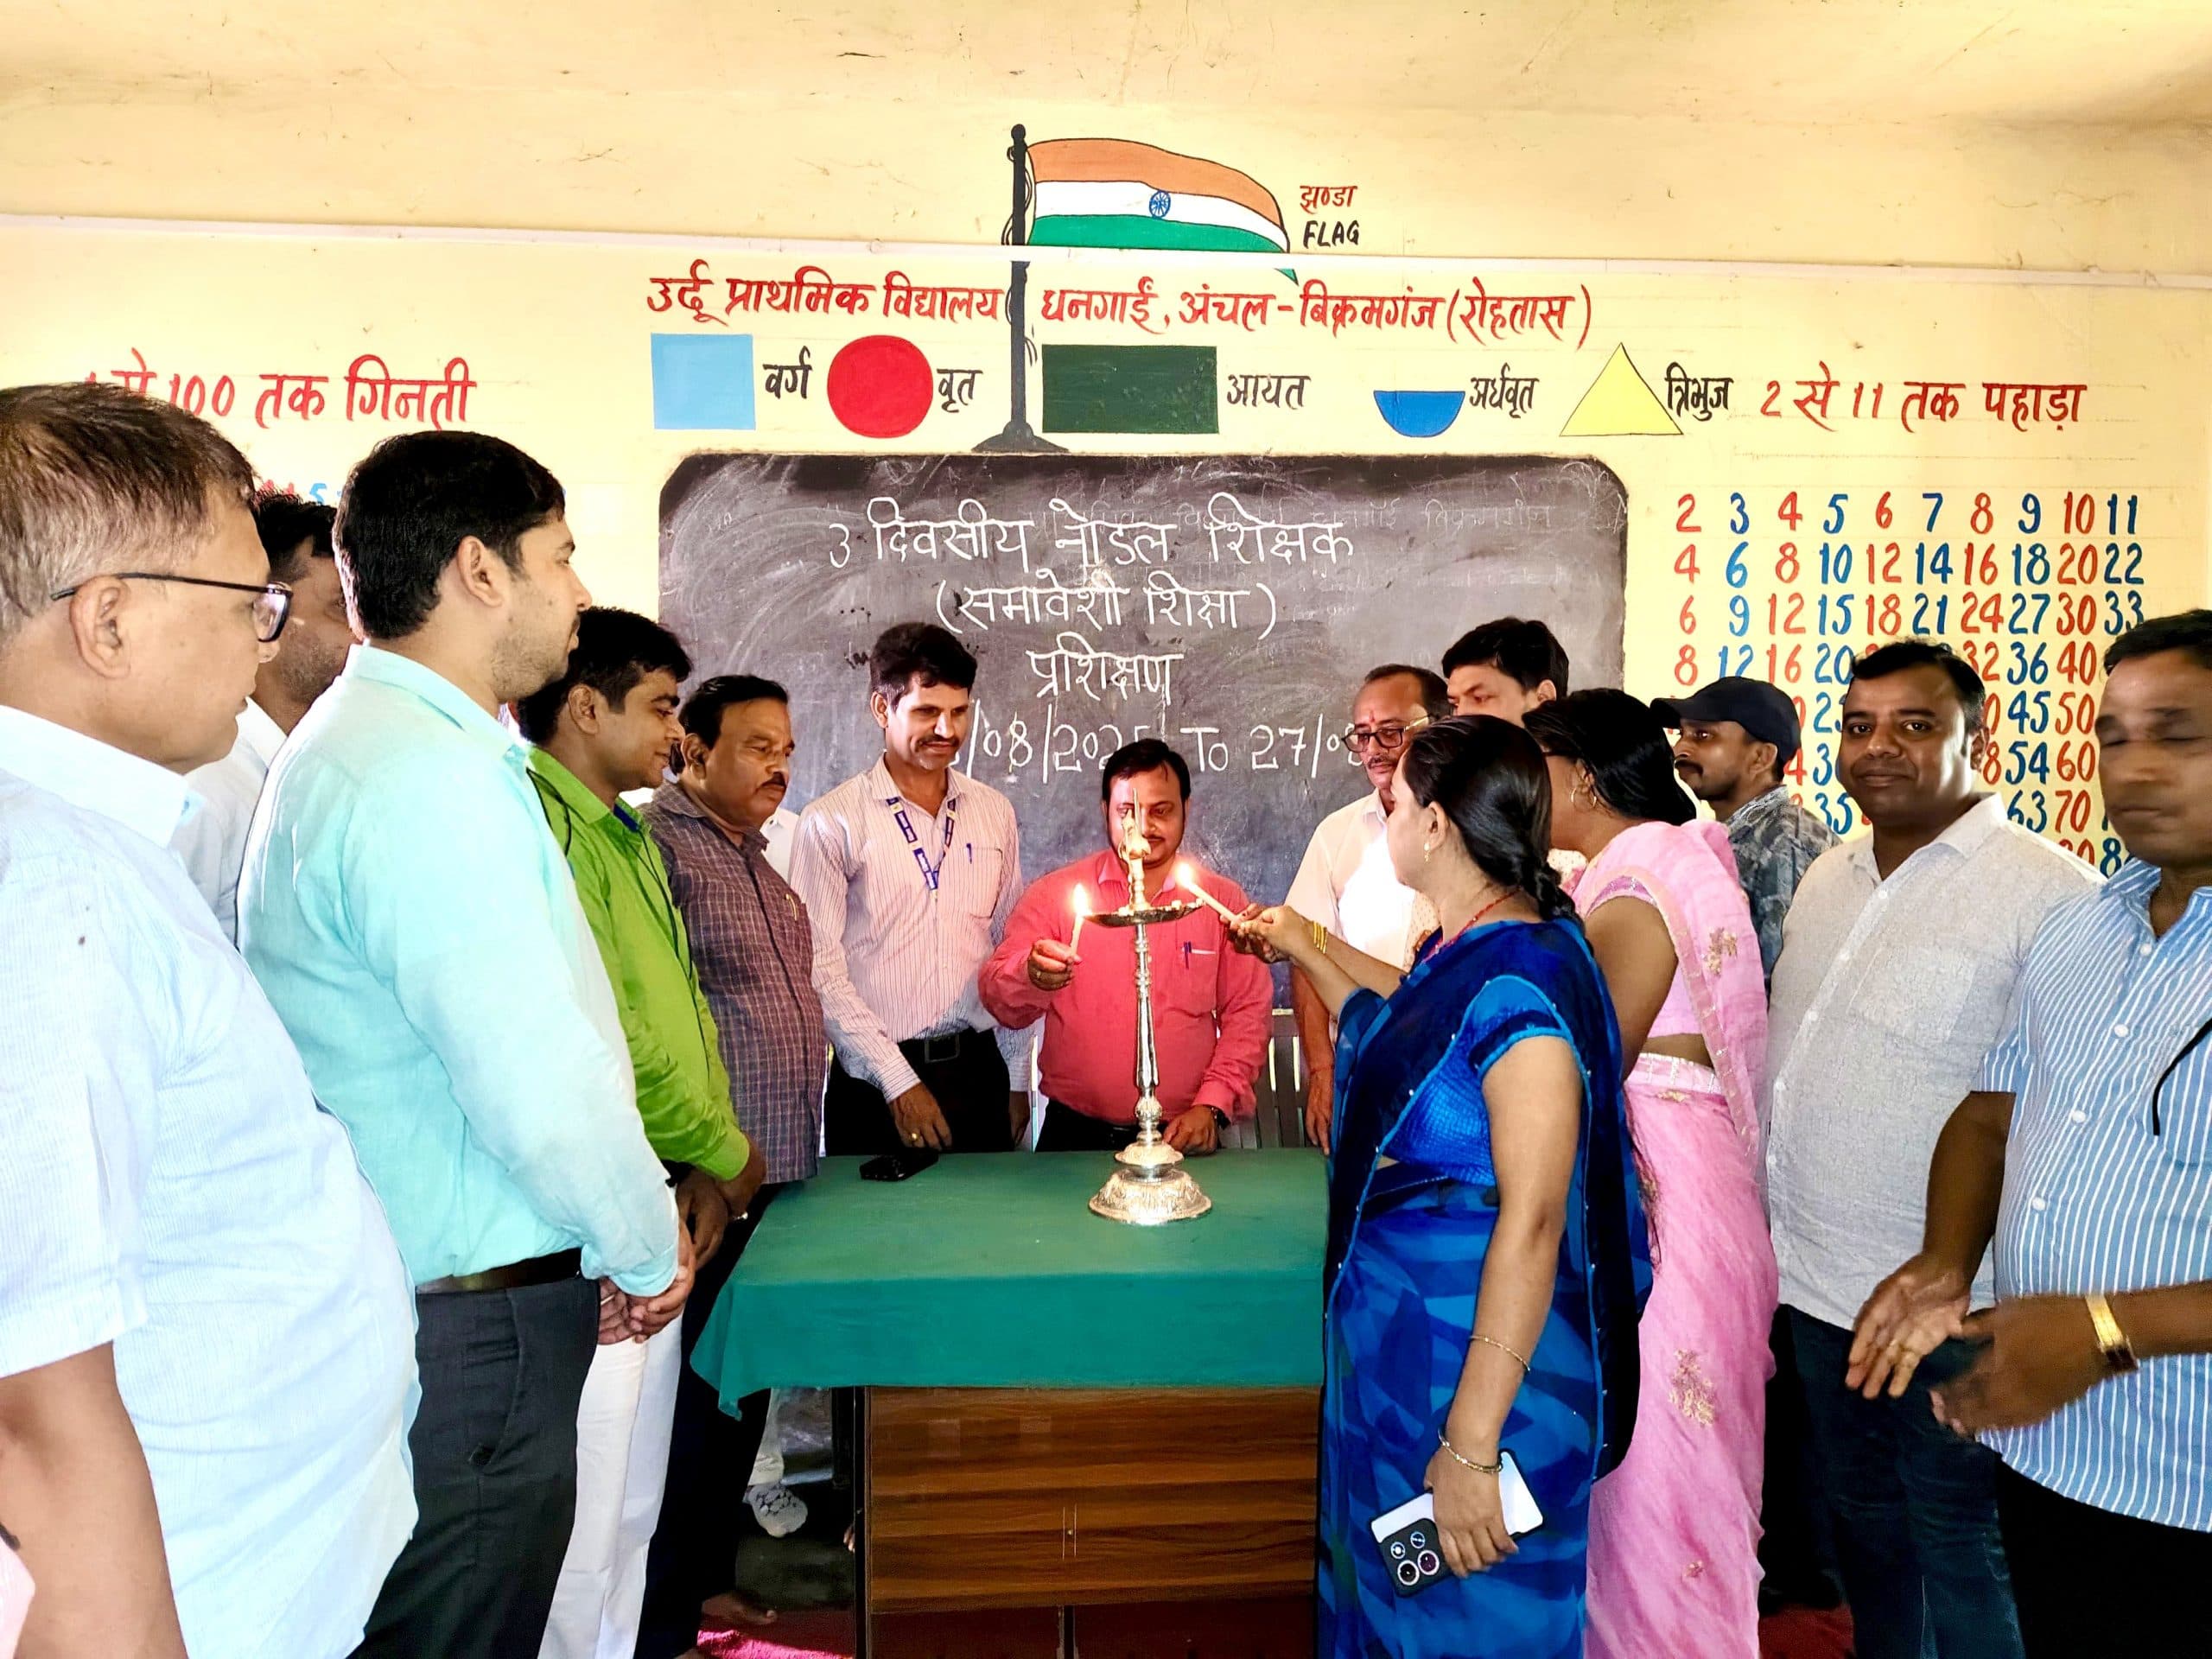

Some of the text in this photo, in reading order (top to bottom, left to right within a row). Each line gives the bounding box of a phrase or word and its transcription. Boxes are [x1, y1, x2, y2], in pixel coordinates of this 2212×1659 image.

[1303, 220, 1360, 249] FLAG
[647, 259, 728, 327] उर्दू
[726, 266, 875, 316] प्राथमिक
[882, 271, 1006, 323] विद्यालय
[168, 373, 235, 417] 100
[255, 372, 329, 429] तक
[345, 353, 478, 431] गिनती
[762, 346, 812, 399] वर्ग
[937, 367, 983, 414] वृत
[1226, 373, 1311, 410] आयत
[1664, 362, 1734, 422] त्रिभुज
[1760, 360, 2088, 433] 2 से 11 तक पहाड़ा
[867, 496, 1036, 573] दिवसीय
[1049, 498, 1178, 567] नोडल
[1204, 492, 1354, 564] शिक्षक
[1675, 491, 2138, 535] 2 3 4 5 6 7 8 9 10 11
[1674, 541, 2145, 588] 4 6 8 10 12 14 16 18 20 22
[1679, 589, 2144, 637] 6 9 12 15 18 21 24 27 30 33
[1026, 631, 1185, 706] प्रशिक्षण
[1674, 644, 1698, 686] 8
[1766, 644, 1802, 683] 16
[1815, 643, 1855, 685] 20
[1962, 639, 2000, 681] 32
[2007, 641, 2049, 685] 36
[2056, 641, 2097, 686] 40
[2007, 690, 2051, 734] 45
[2055, 691, 2095, 734] 50
[1813, 743, 1840, 786] 3
[2005, 741, 2050, 785] 54
[2056, 741, 2096, 782] 60
[1815, 790, 2091, 835] 35 63 70
